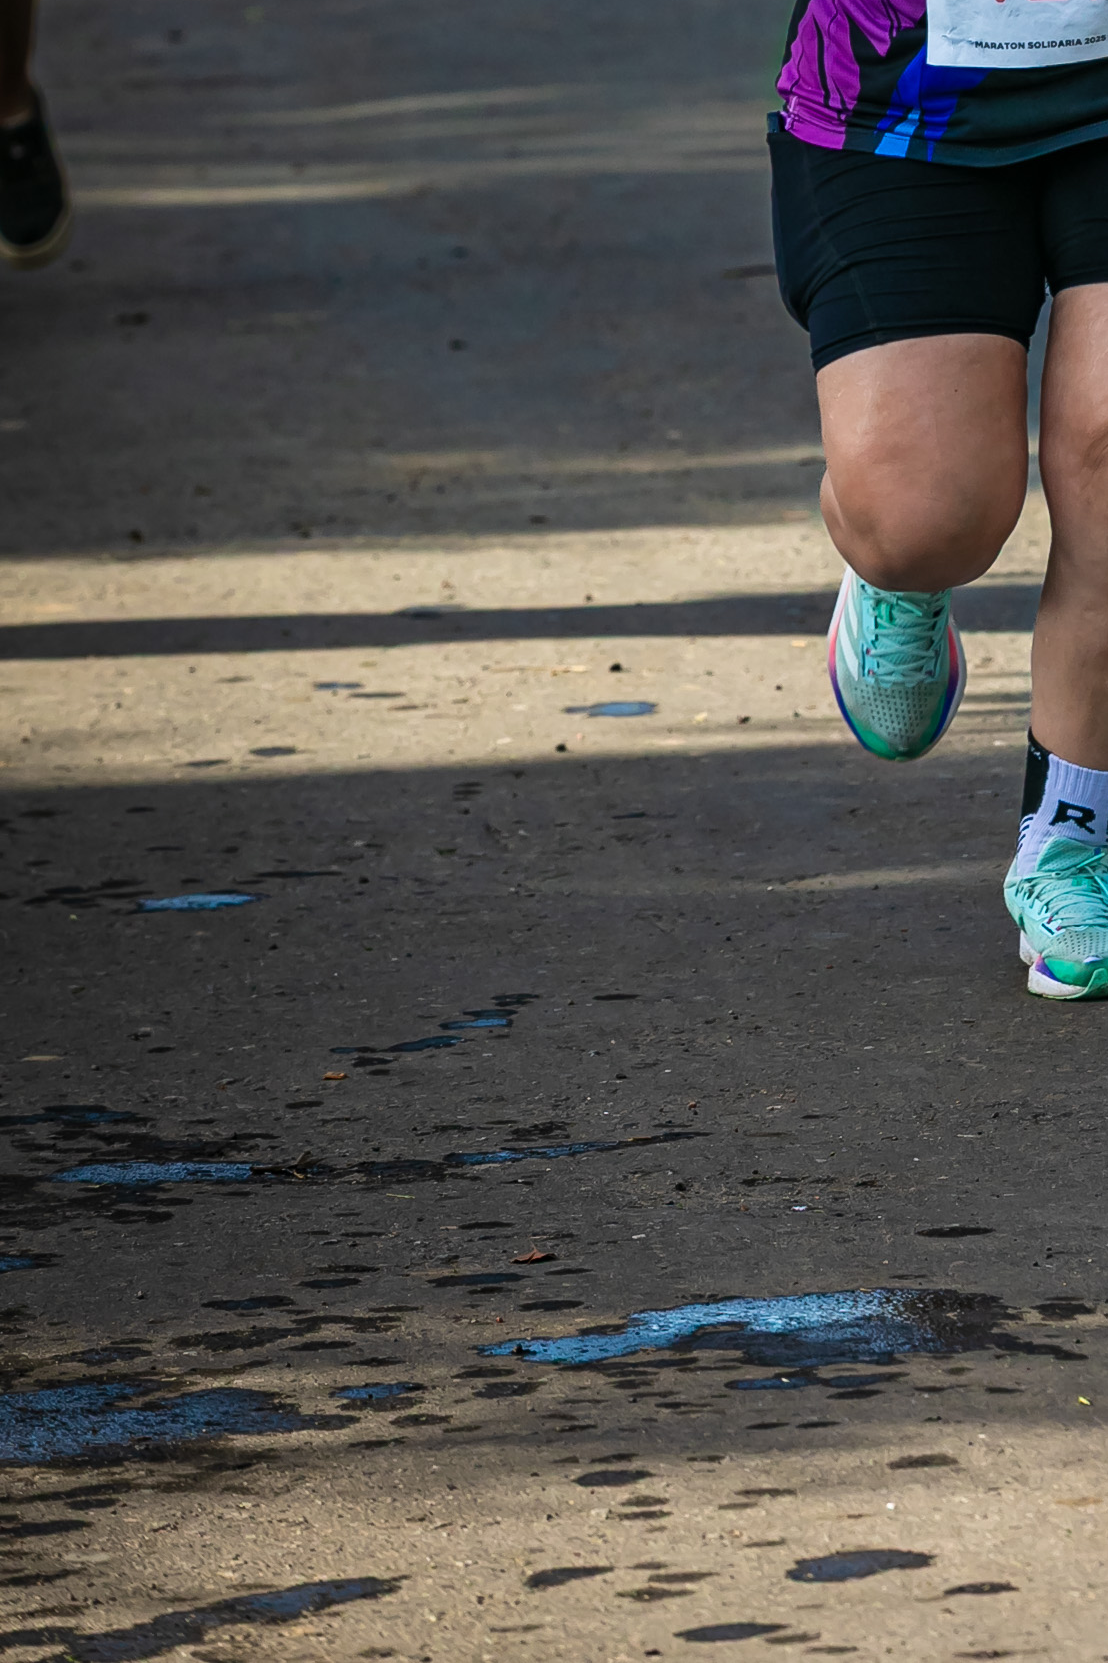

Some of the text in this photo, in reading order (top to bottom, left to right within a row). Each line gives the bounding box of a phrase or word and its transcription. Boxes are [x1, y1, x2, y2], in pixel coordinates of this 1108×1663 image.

[975, 34, 1107, 50] MARATON SOLIDARIA 2025
[1048, 799, 1097, 834] R
